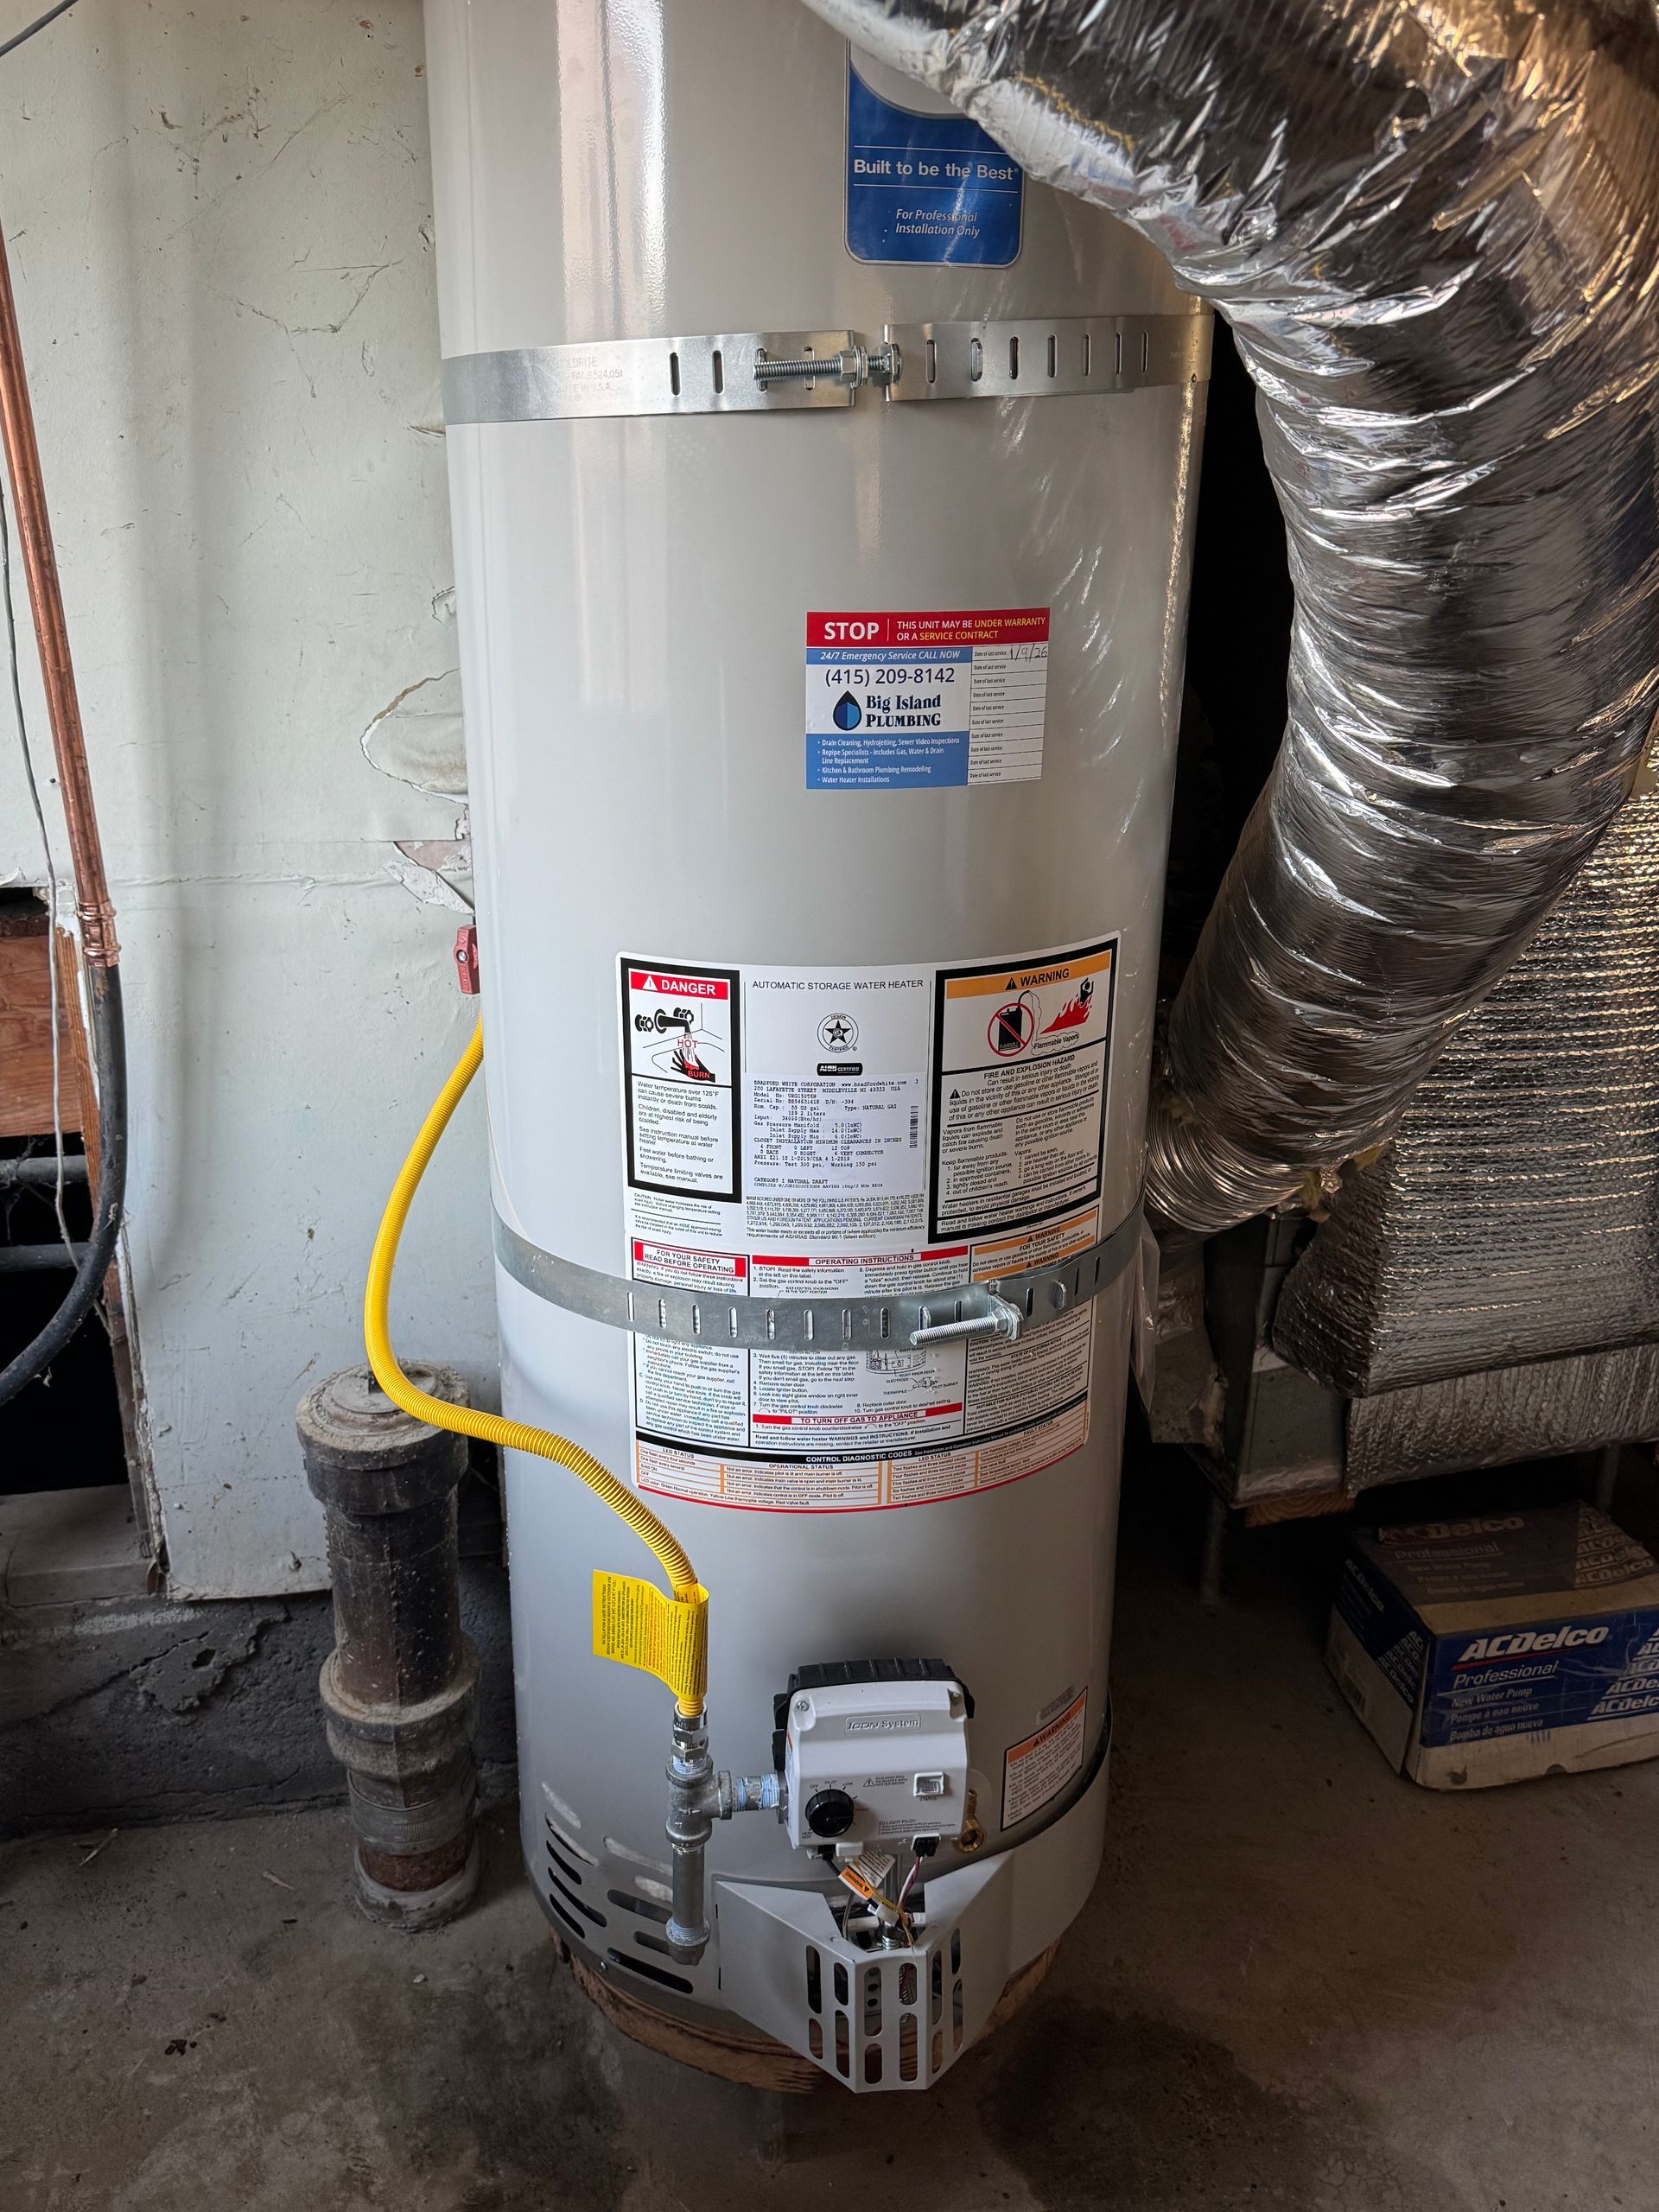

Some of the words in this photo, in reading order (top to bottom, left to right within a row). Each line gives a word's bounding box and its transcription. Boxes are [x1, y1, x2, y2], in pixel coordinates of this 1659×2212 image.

[854, 159, 891, 174] Built
[896, 162, 912, 175] to
[918, 162, 939, 175] be
[945, 163, 970, 177] the
[896, 209, 912, 219] For
[915, 209, 977, 222] Professional
[896, 224, 953, 234] Installation
[957, 225, 980, 238] Only
[975, 619, 1002, 627] UNDER
[1004, 617, 1046, 626] WARRANTY
[824, 622, 879, 639] STOP
[956, 631, 999, 639] CONTRACT
[842, 652, 887, 662] Emergency
[826, 669, 869, 687] (415)
[875, 667, 955, 684] 209-8142
[866, 696, 891, 714] Big
[896, 694, 941, 709] Island
[866, 713, 941, 728] PLUMBING
[888, 980, 923, 988] HEATER
[1020, 969, 1070, 986] WARNING
[662, 980, 715, 995] DANGER
[677, 1039, 697, 1048] HOT
[1033, 1039, 1061, 1049] Flammable
[1063, 1033, 1078, 1044] Vapors
[1016, 1061, 1051, 1074] EXPLOSION
[1052, 1054, 1075, 1065] HAZARD
[1021, 1071, 1039, 1080] serious
[1040, 1068, 1052, 1077] injury
[655, 1085, 687, 1094] temperature
[1035, 1227, 1060, 1239] WARNING
[1032, 1239, 1047, 1249] YOUR
[1047, 1232, 1065, 1243] SAFETY
[672, 1252, 691, 1261] YOUR
[861, 1255, 913, 1263] INSTRUCTIONS
[1034, 1253, 1058, 1265] WARNING
[664, 1258, 690, 1268] BEFORE
[693, 1263, 734, 1273] OPERATING
[879, 1412, 918, 1421] APPLIANCE
[1039, 1421, 1053, 1431] STATUS
[842, 1453, 887, 1462] DIAGNOSTIC
[887, 1450, 912, 1459] CODES
[1459, 1625, 1609, 1662] ACDelco
[1452, 1660, 1559, 1689] Professional
[1452, 1698, 1473, 1708] New
[1477, 1693, 1505, 1703] Water
[1507, 1688, 1532, 1698] Pump
[1451, 1713, 1482, 1723] Pompe
[1492, 1707, 1509, 1716] eau
[1511, 1702, 1541, 1713] neuve
[881, 1720, 918, 1729] System
[1039, 1712, 1071, 1743] WARNING
[1451, 1728, 1480, 1740] Bomba
[1483, 1726, 1493, 1735] de
[1495, 1723, 1516, 1734] agua
[1518, 1719, 1543, 1730] nueva
